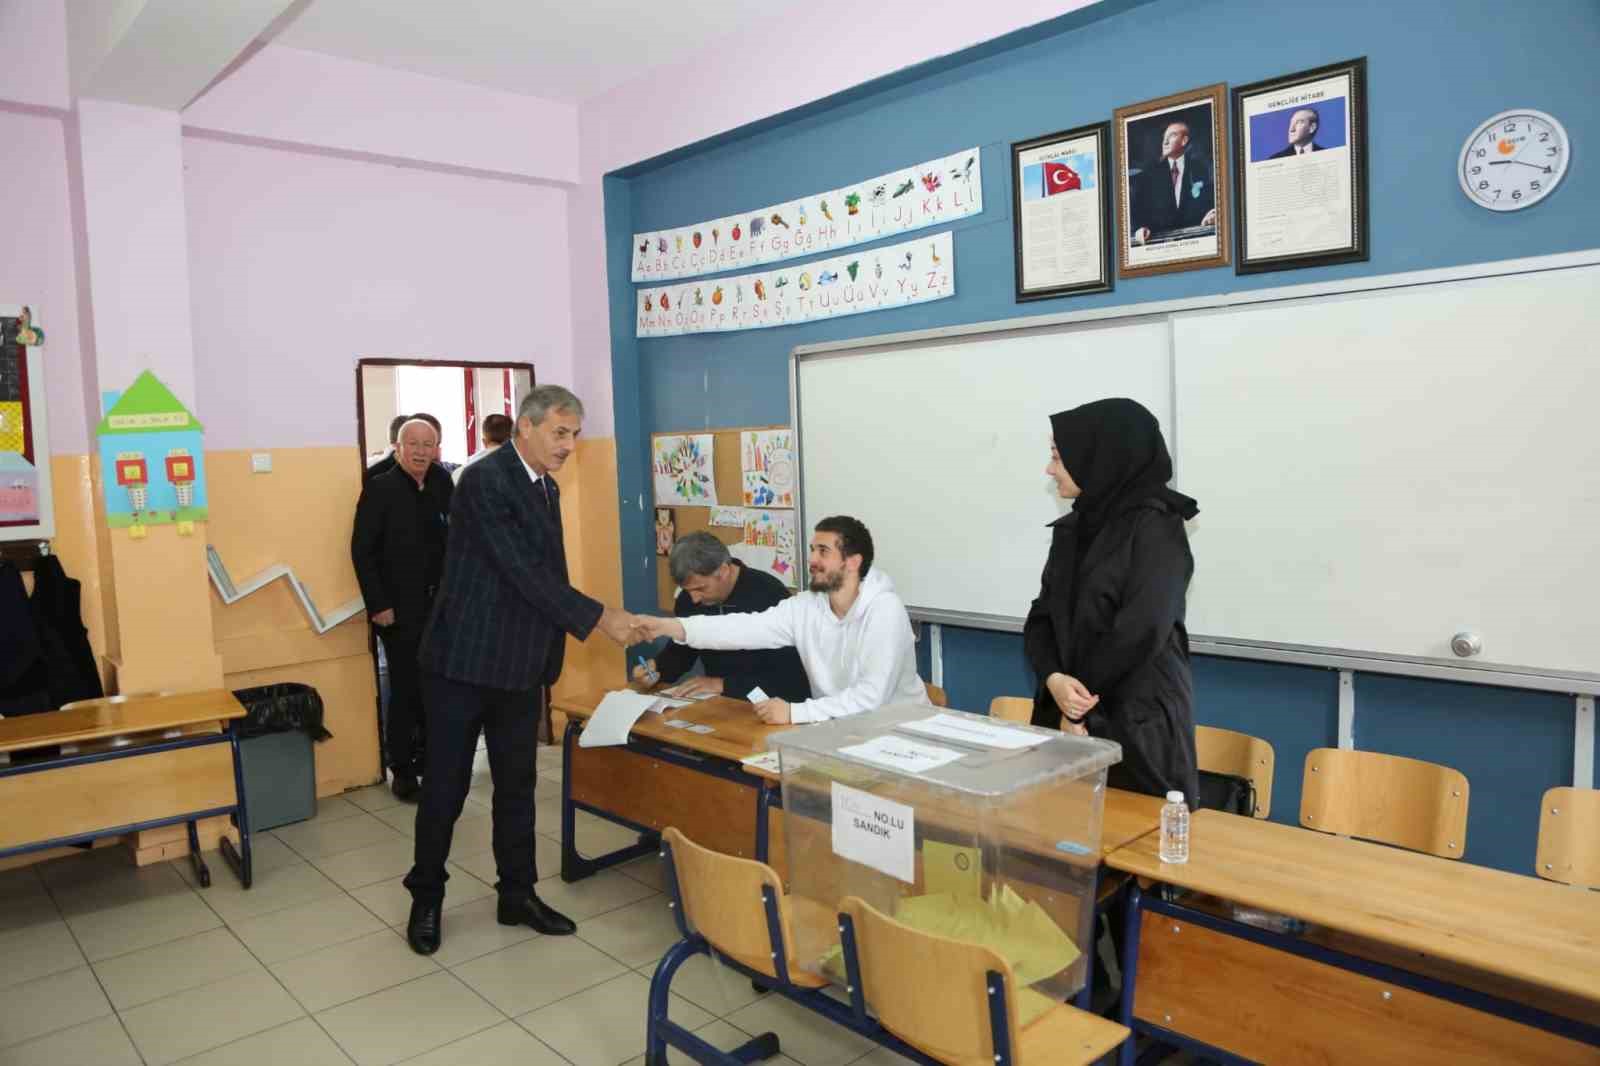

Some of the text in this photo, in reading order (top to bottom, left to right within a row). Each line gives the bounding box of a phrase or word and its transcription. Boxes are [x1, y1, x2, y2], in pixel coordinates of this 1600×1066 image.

[1503, 123, 1516, 133] 12
[1527, 123, 1532, 133] 1
[1488, 133, 1496, 143] 11
[1539, 132, 1550, 143] 2
[1475, 148, 1486, 158] 10
[1546, 146, 1558, 157] 3
[1471, 166, 1481, 175] 9
[1479, 180, 1489, 190] 8
[1530, 180, 1540, 191] 5
[1492, 189, 1502, 199] 7
[1511, 190, 1522, 200] 6
